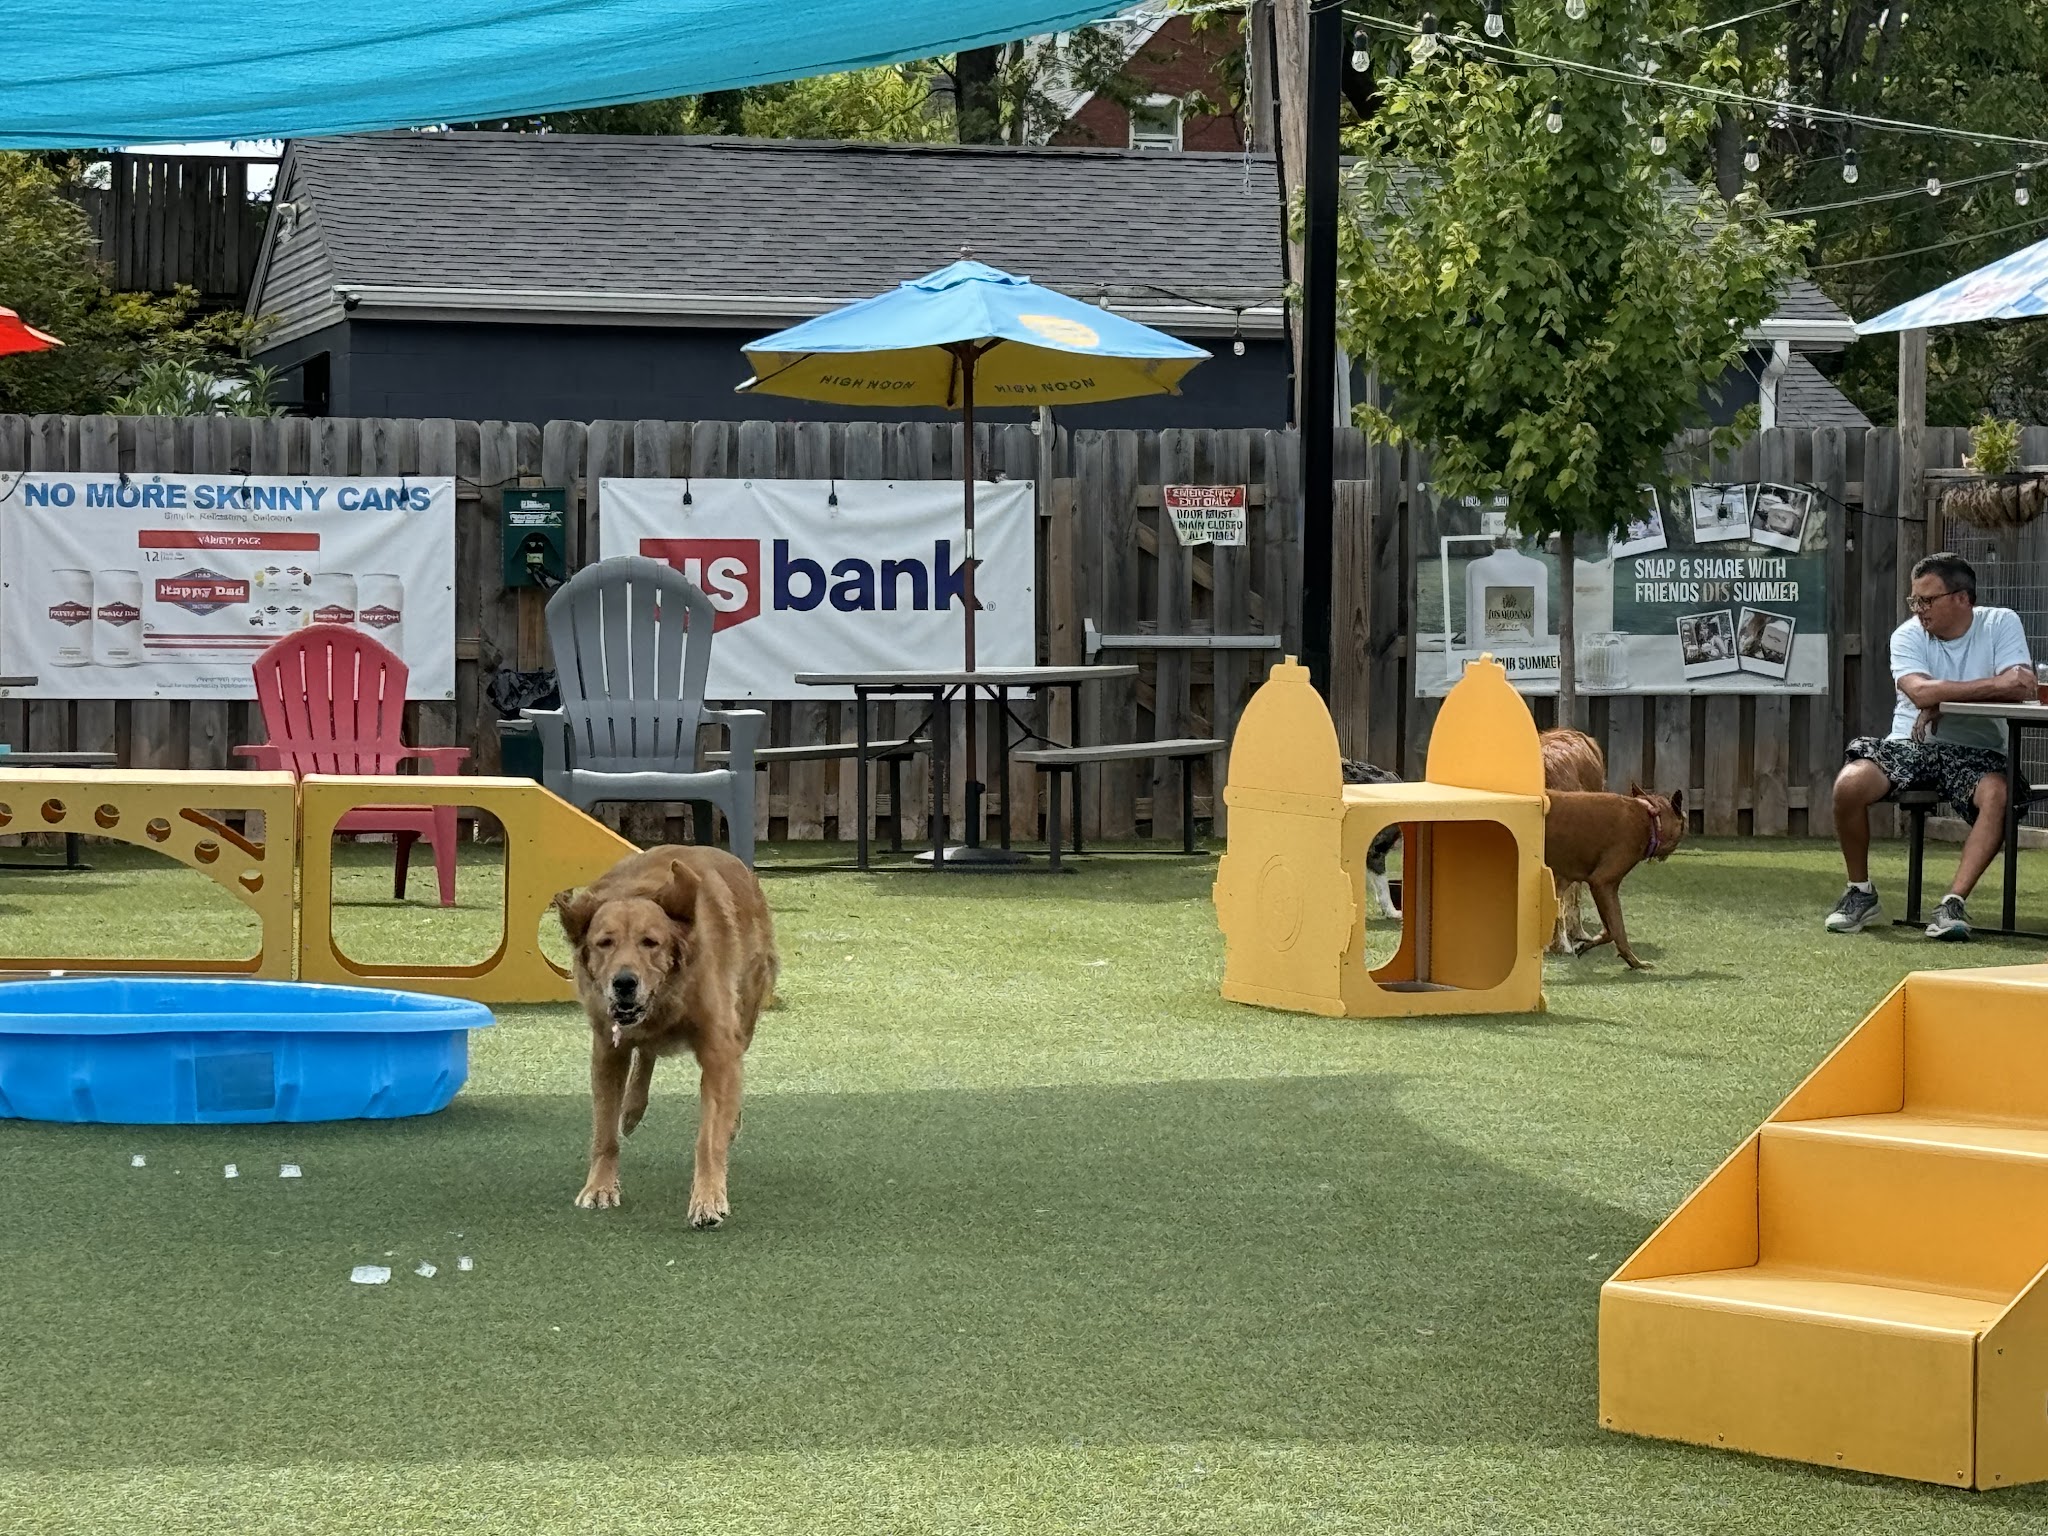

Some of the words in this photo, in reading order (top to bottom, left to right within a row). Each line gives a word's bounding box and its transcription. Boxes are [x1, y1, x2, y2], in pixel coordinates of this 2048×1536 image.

[820, 375, 864, 388] HIGH
[866, 380, 915, 390] NOON
[1041, 377, 1096, 392] NOON
[24, 482, 76, 507] NO
[86, 483, 188, 510] MORE
[193, 485, 328, 512] SKNNY
[773, 539, 984, 612] bank
[1635, 558, 1676, 579] SNAP
[1680, 558, 1690, 579] &
[1694, 558, 1745, 579] SHARE
[1748, 557, 1787, 579] WITH
[160, 584, 212, 599] Happy
[215, 586, 245, 597] Dad
[1635, 581, 1699, 603] FRIENDS
[1703, 581, 1731, 602] DIS
[1733, 581, 1799, 602] SUMMER
